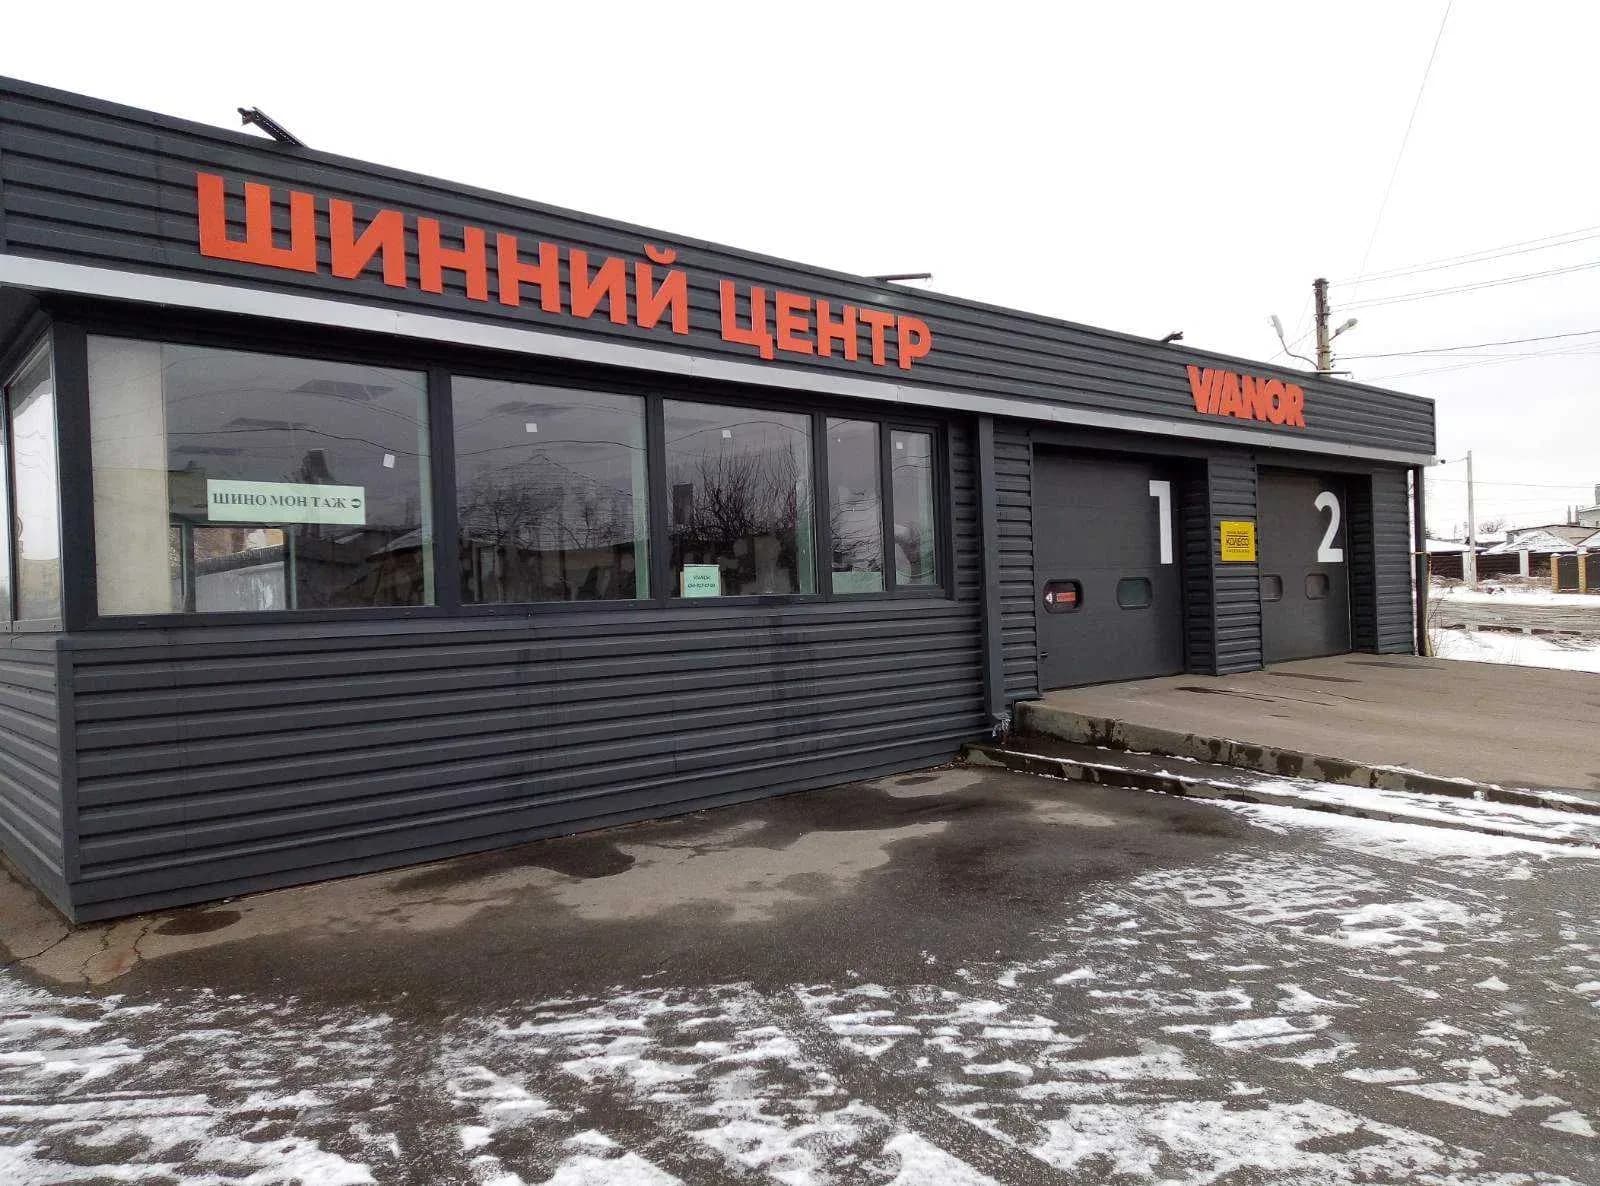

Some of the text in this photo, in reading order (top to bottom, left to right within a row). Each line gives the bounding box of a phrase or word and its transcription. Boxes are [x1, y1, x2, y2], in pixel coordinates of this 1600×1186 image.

[197, 172, 933, 370] ШИННИЙ ЦЕНТР
[1187, 365, 1305, 428] VIANOR
[1149, 480, 1173, 565] 1
[1314, 491, 1344, 563] 2
